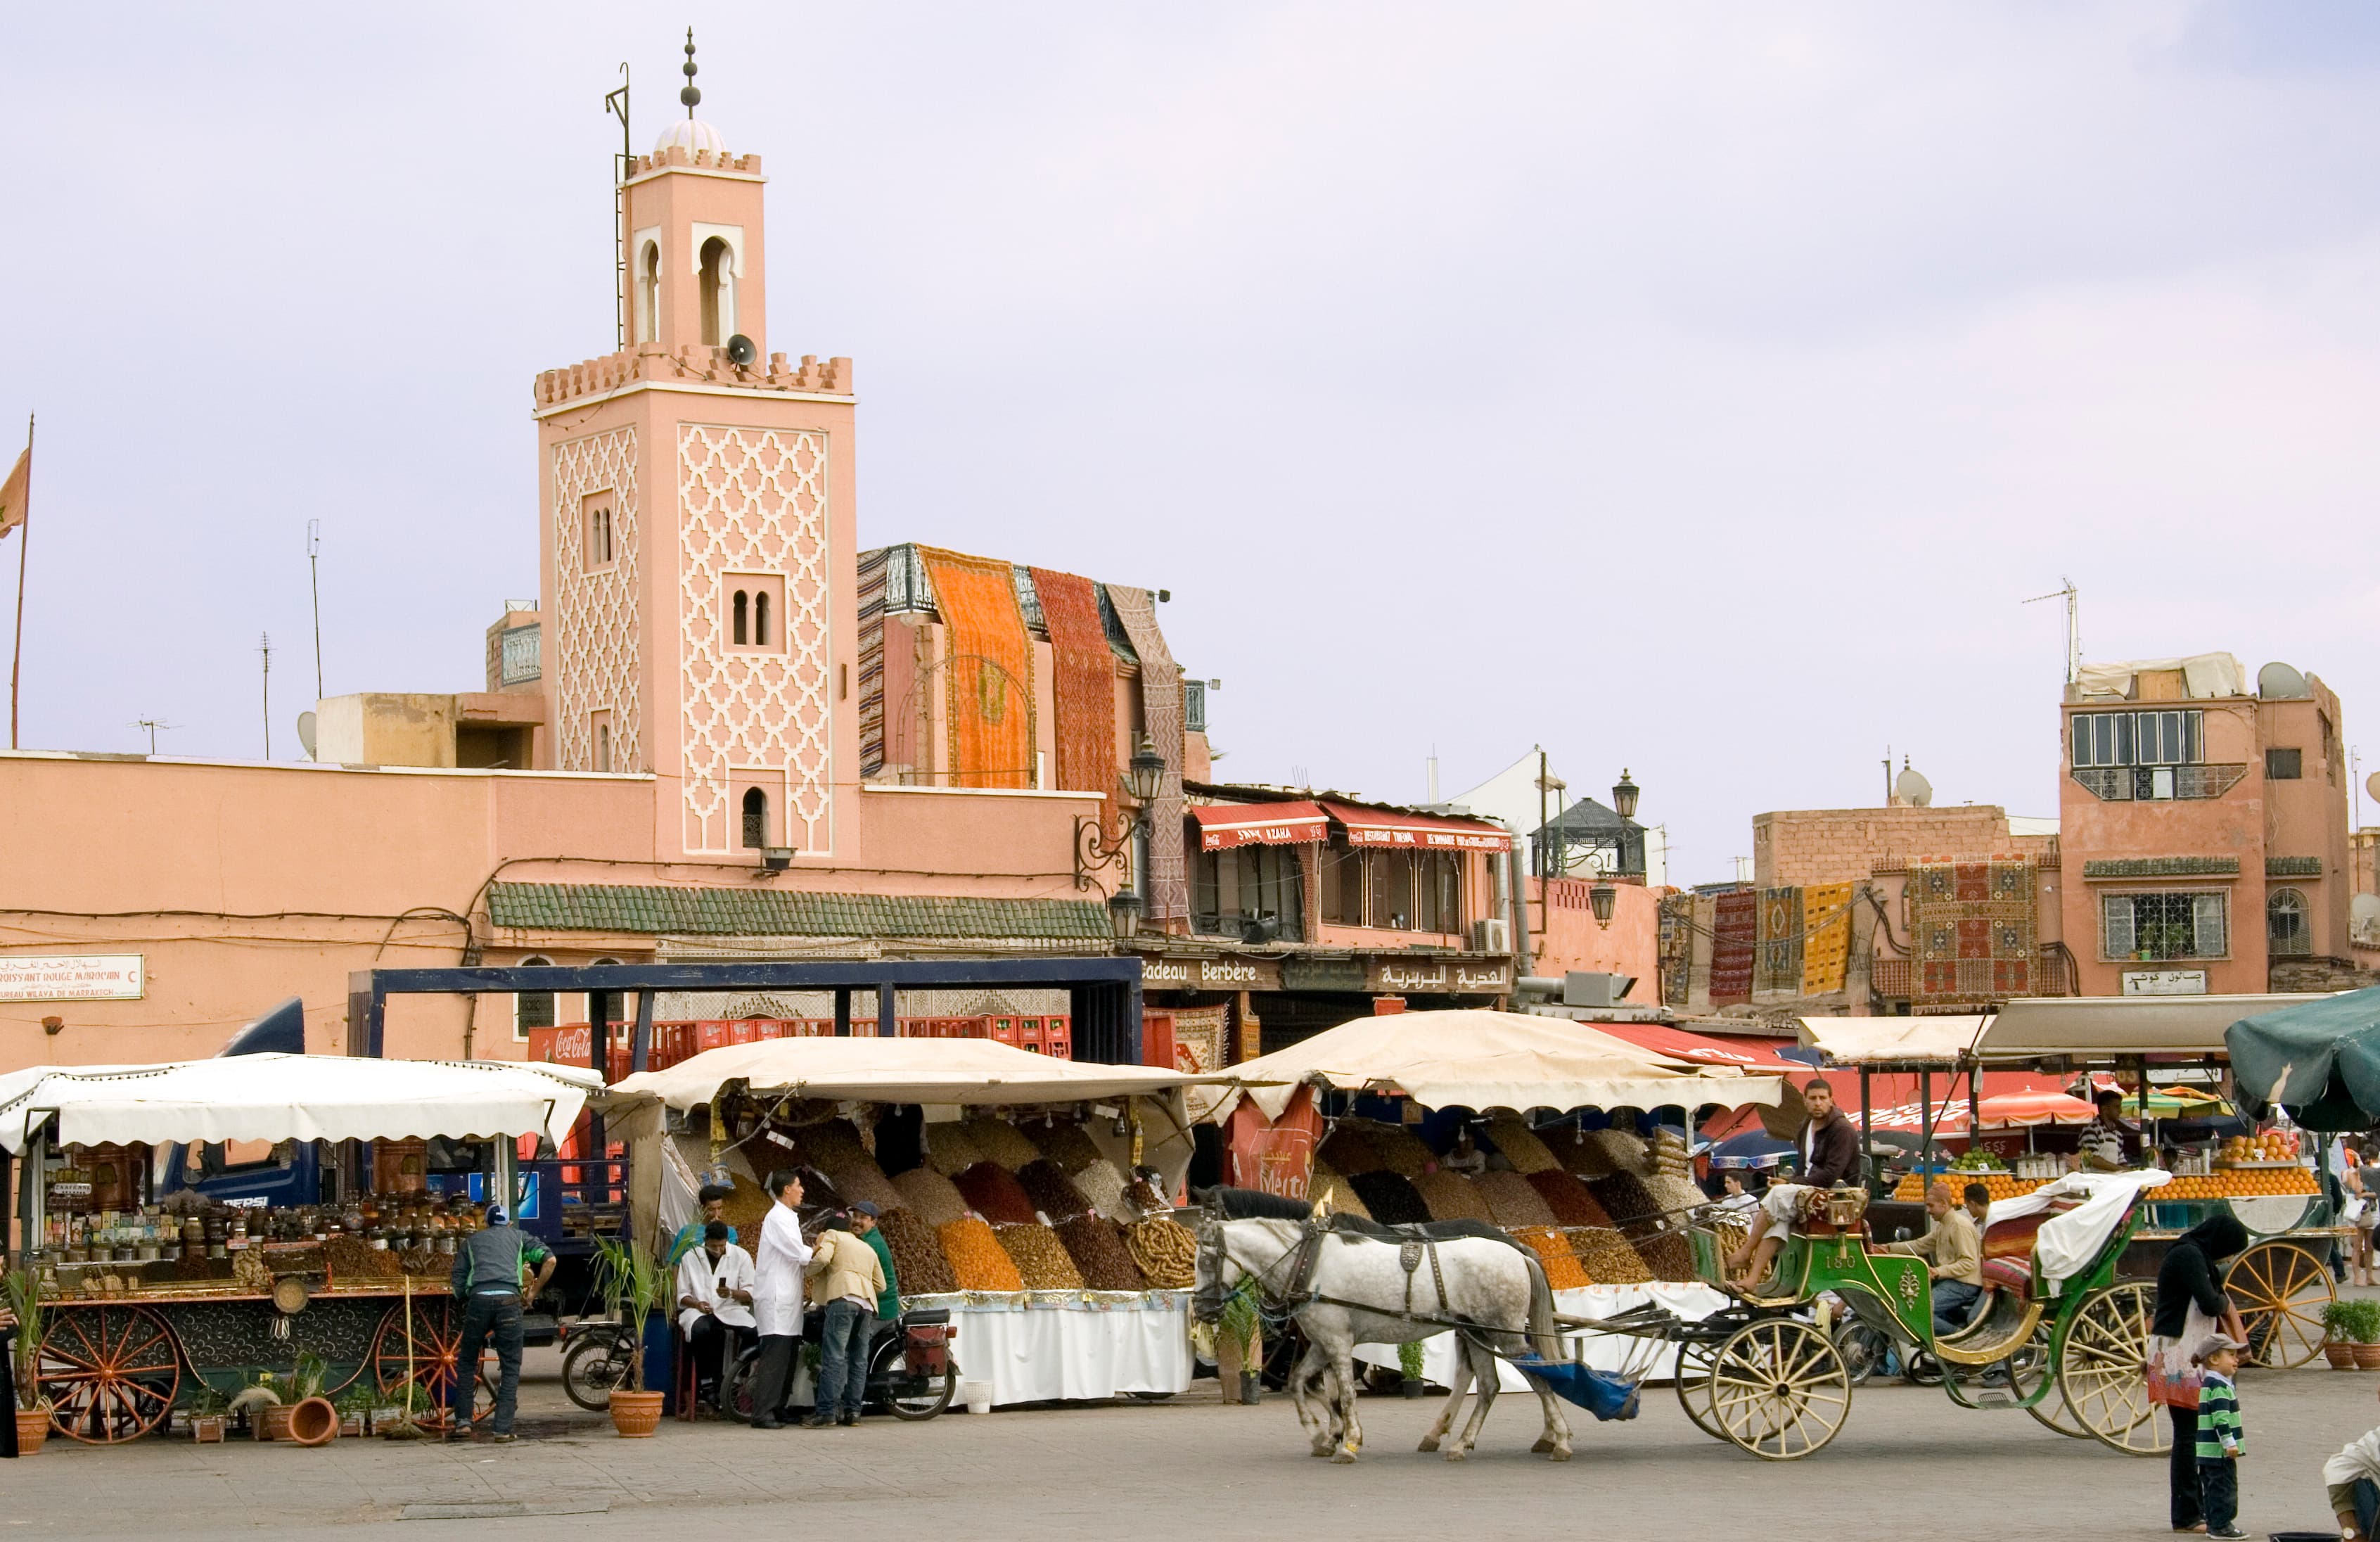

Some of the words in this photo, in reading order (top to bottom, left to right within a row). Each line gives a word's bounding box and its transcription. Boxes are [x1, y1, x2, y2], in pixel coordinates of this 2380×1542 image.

[43, 971, 71, 981] ROUGE
[1201, 960, 1256, 981] Berbère
[1382, 965, 1446, 990] البربرية
[1457, 966, 1506, 989] الهدية
[2168, 972, 2201, 982] صالون
[0, 990, 23, 998] UREAU
[68, 988, 113, 997] MARRAKECH
[1826, 1255, 1855, 1269] 180
